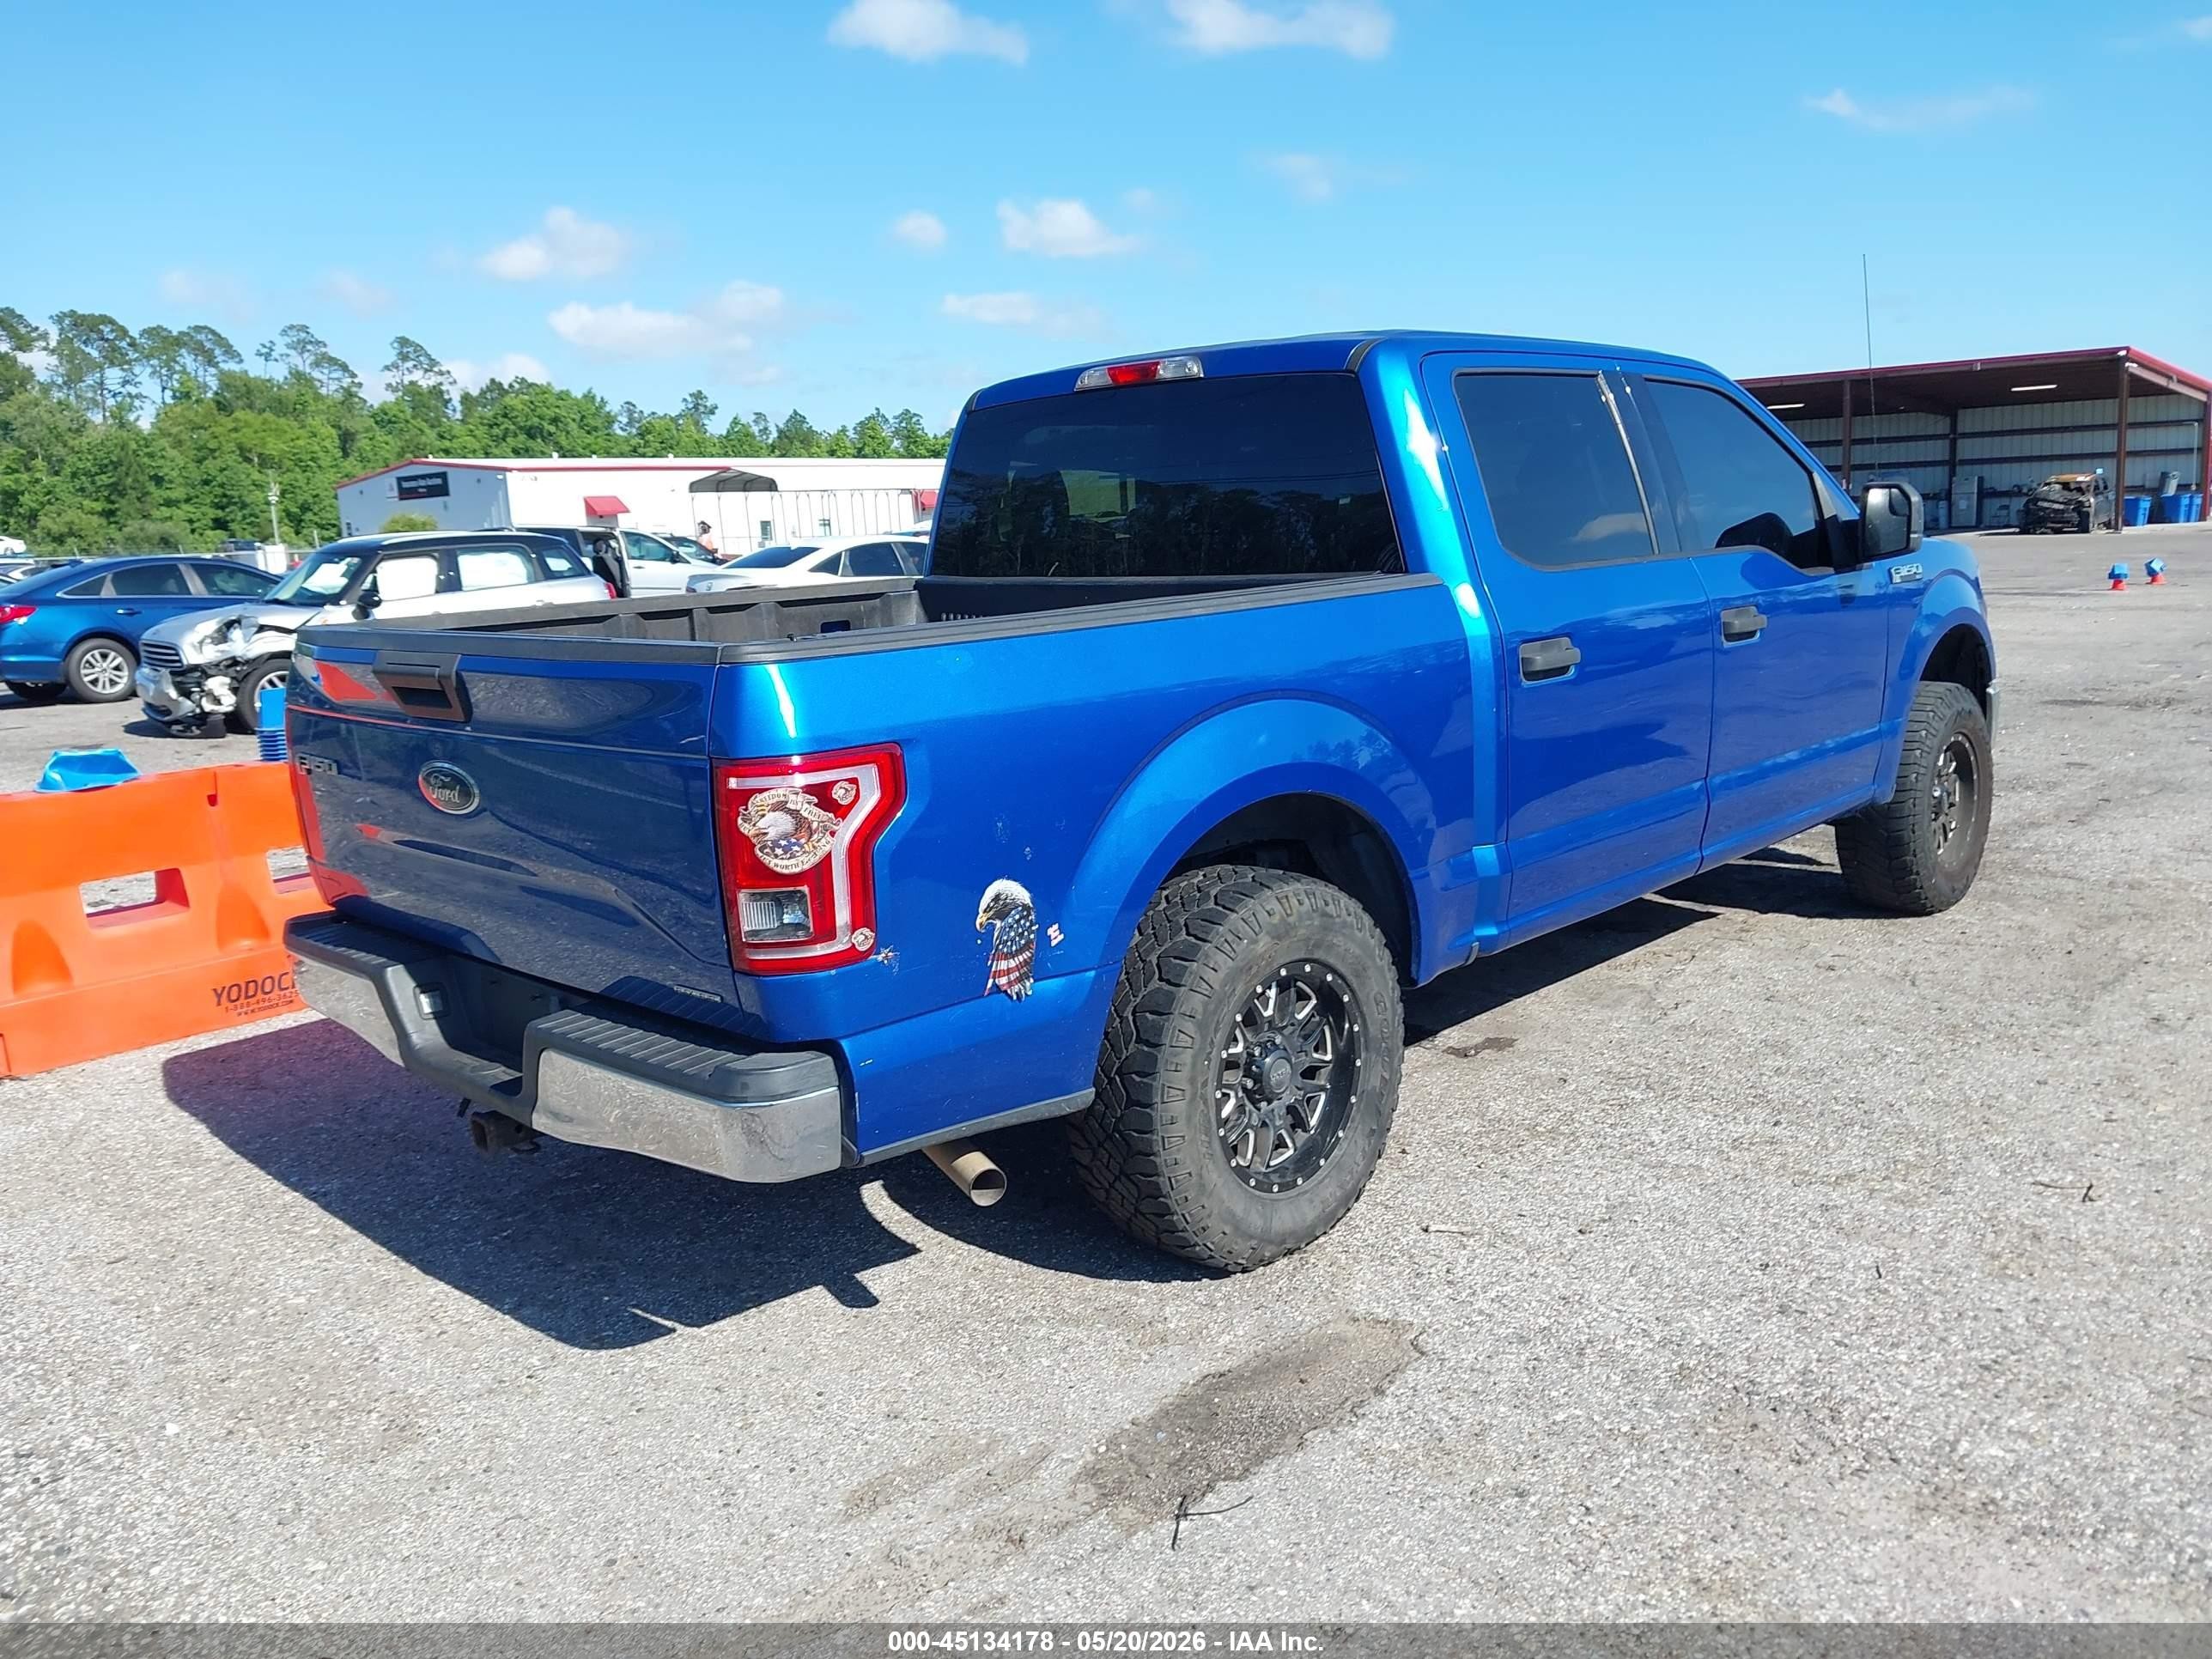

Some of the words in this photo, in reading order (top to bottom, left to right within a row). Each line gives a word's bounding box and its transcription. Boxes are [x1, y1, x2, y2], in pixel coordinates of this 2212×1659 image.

[429, 773, 461, 804] Ford
[774, 862, 799, 871] WORTH
[211, 971, 296, 1007] YODOC
